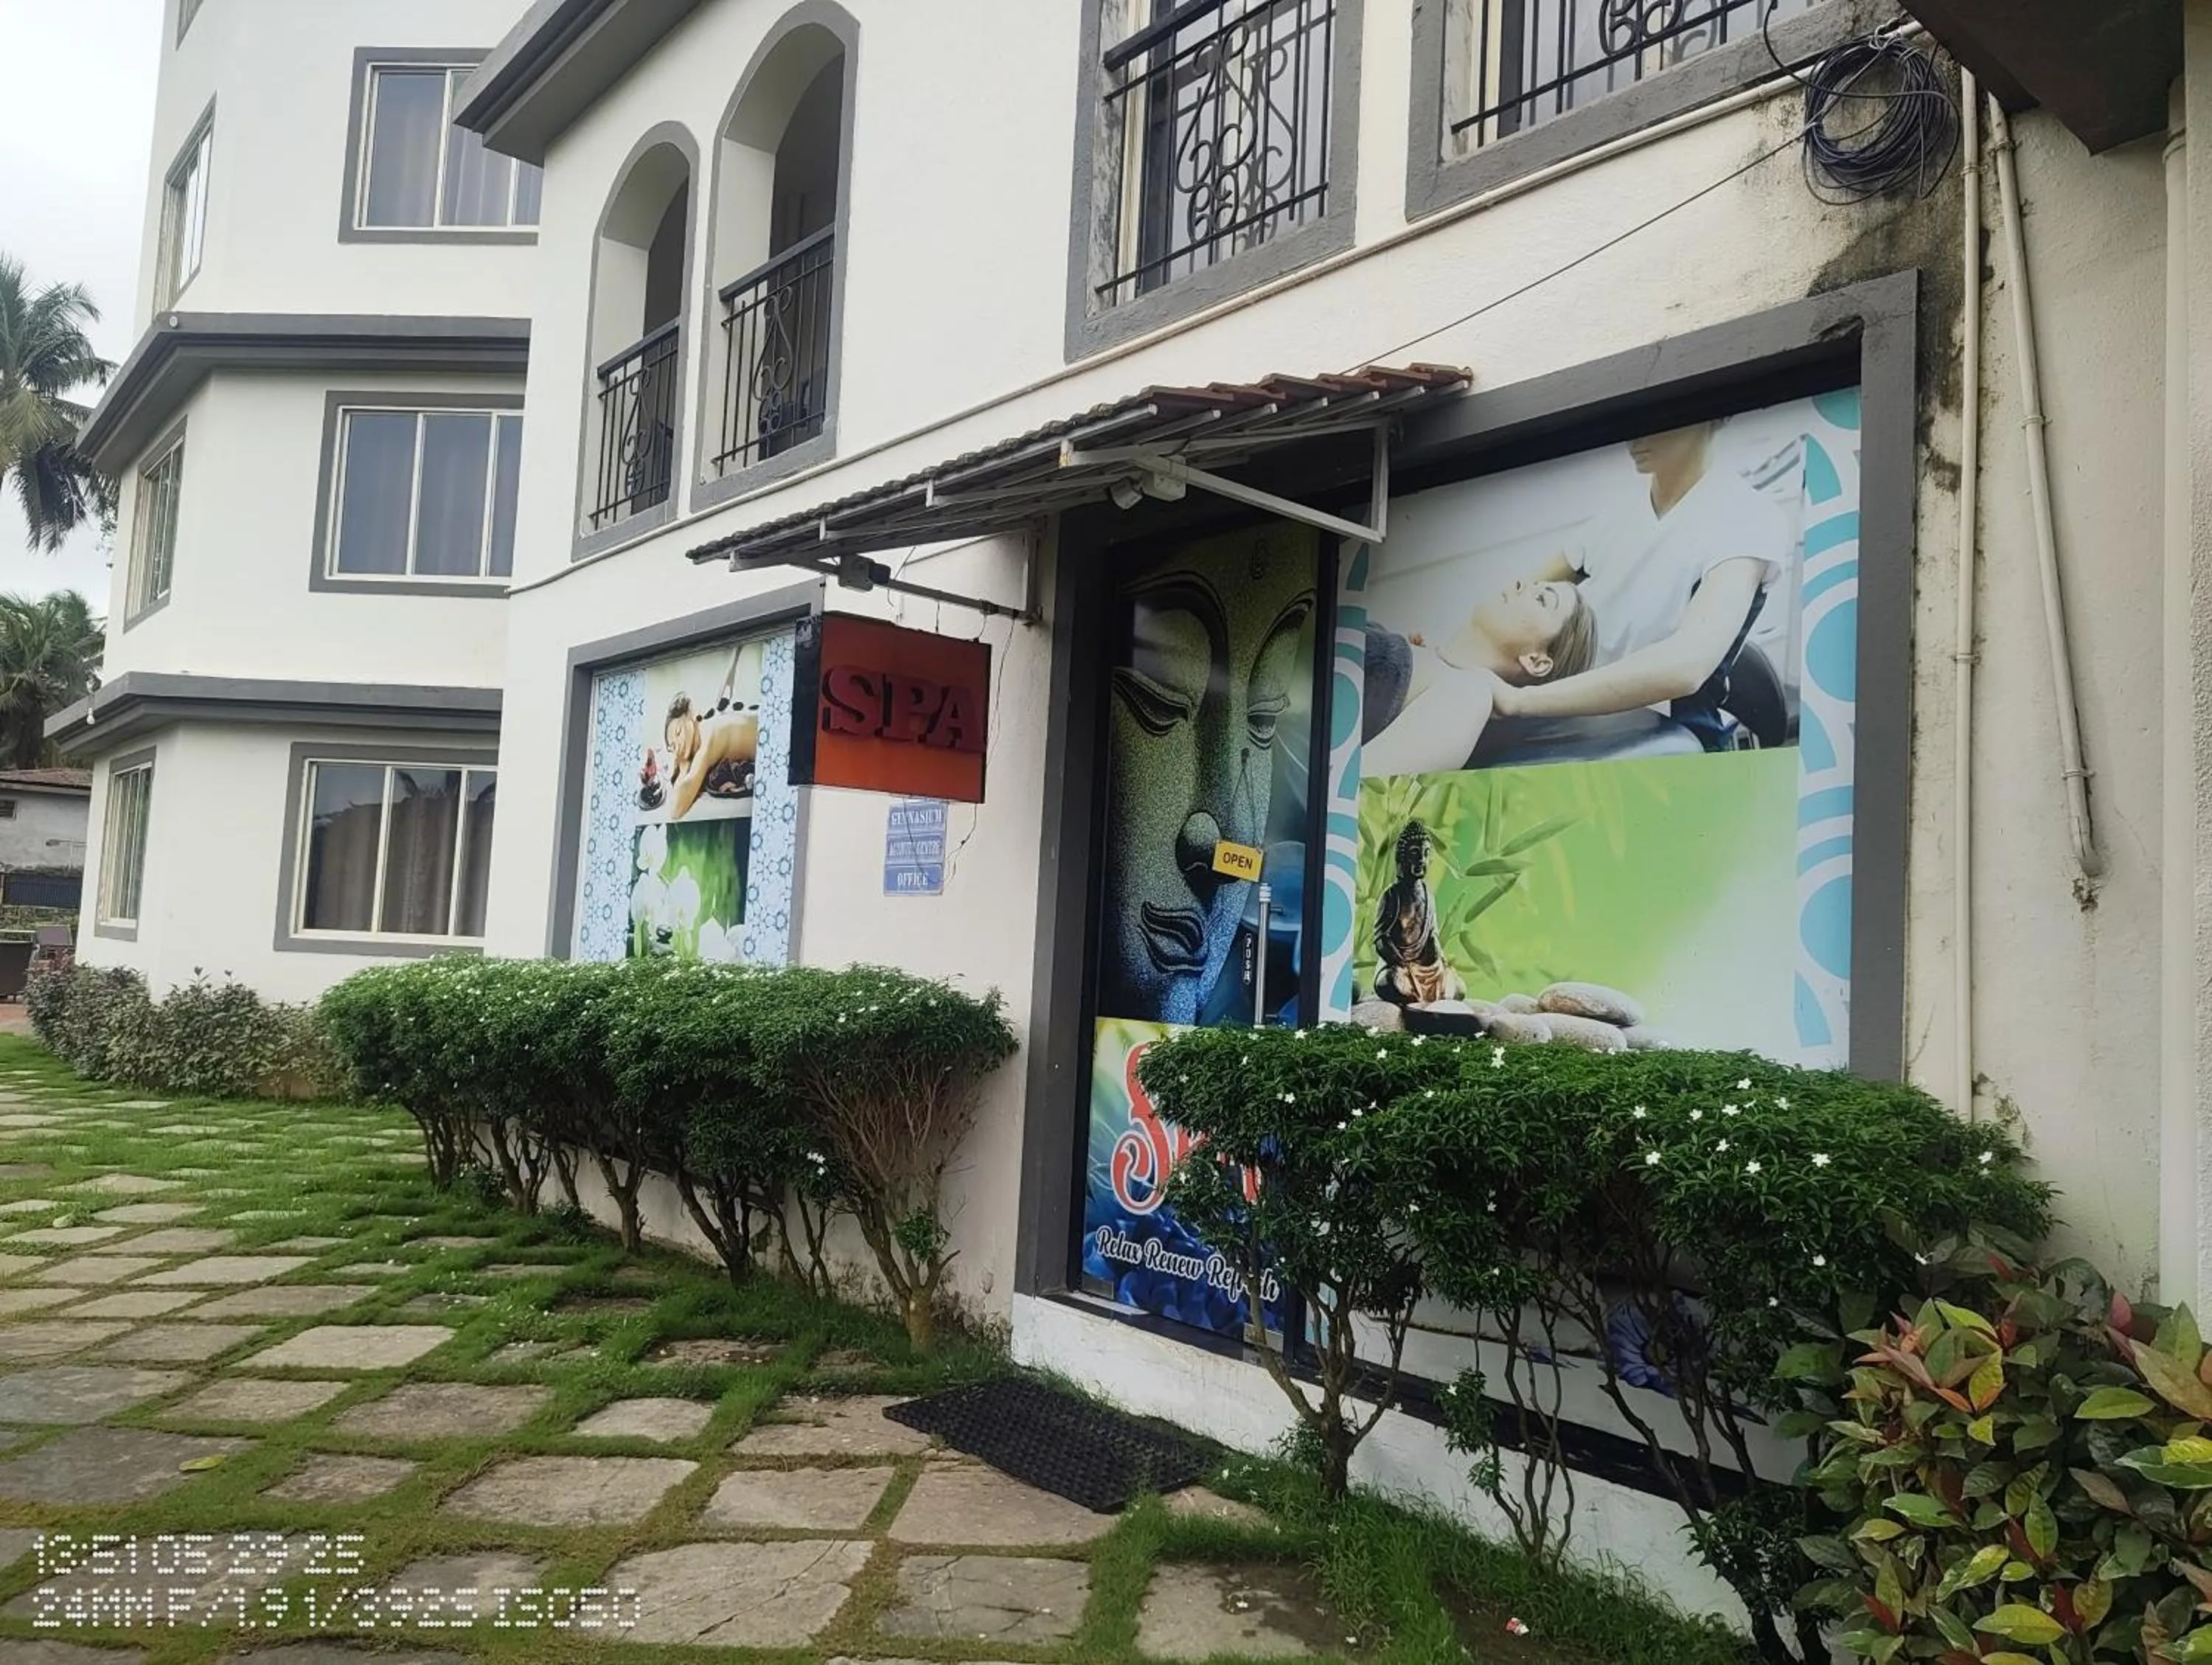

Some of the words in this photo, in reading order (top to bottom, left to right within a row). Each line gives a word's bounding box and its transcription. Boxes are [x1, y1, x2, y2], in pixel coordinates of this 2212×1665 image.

[821, 665, 986, 752] SPA
[897, 872, 928, 886] OFFICE
[1222, 852, 1253, 870] OPEN
[1096, 1225, 1142, 1264] Relax
[1144, 1237, 1204, 1280] Renew
